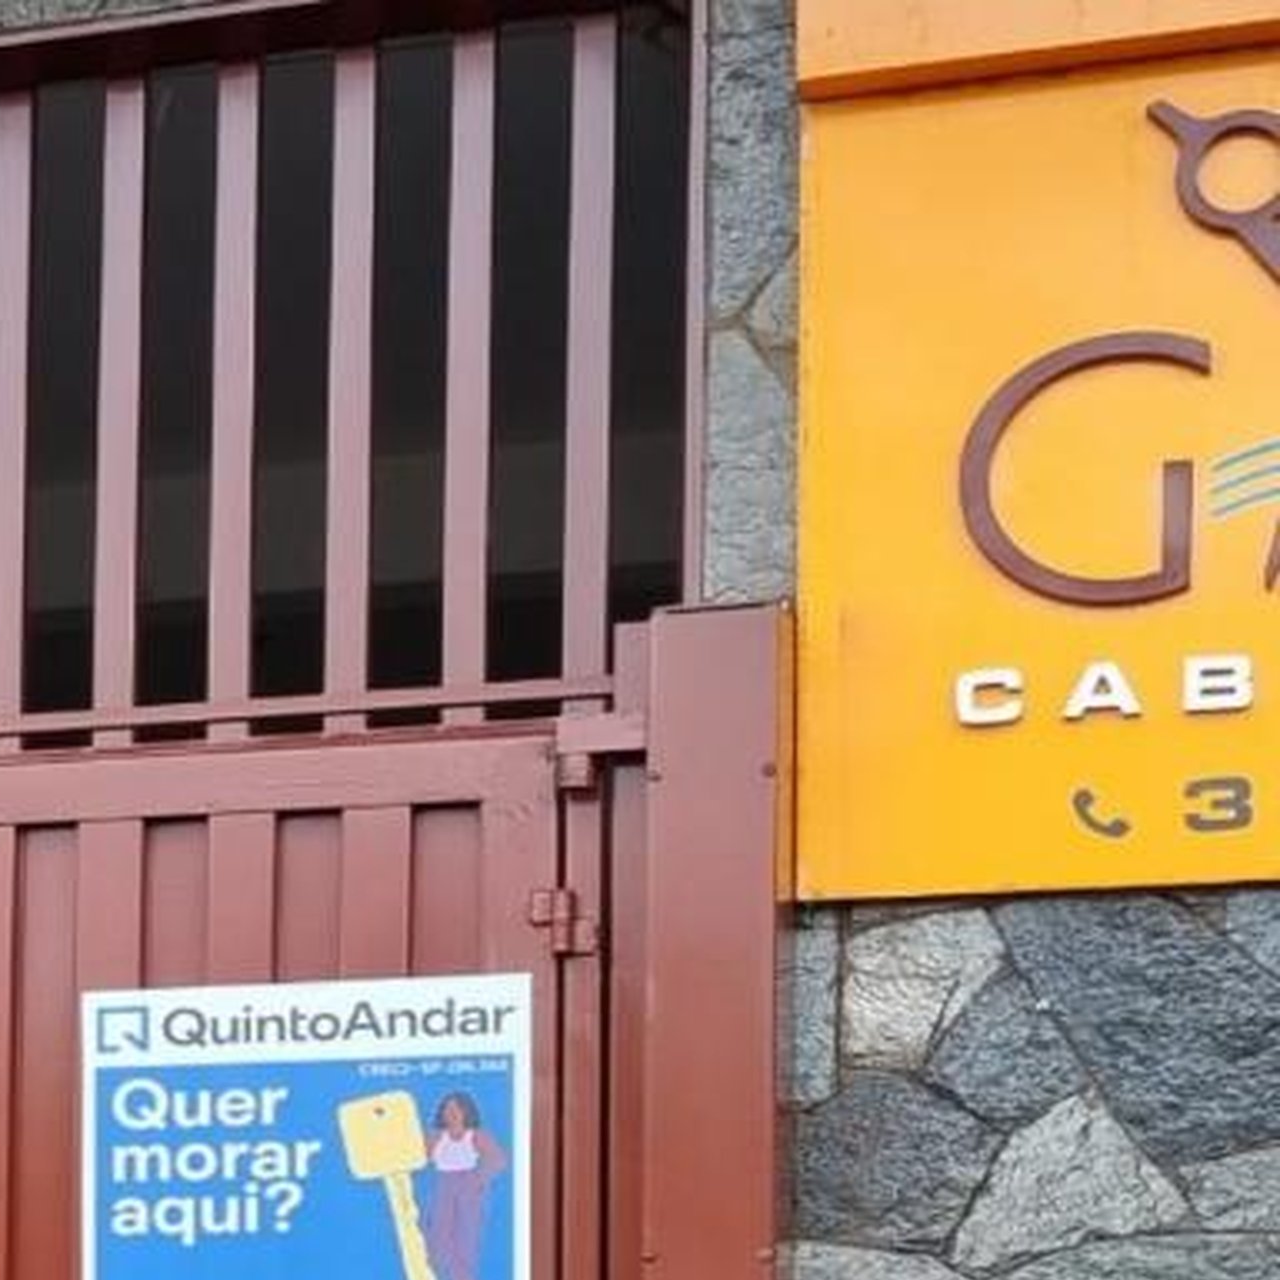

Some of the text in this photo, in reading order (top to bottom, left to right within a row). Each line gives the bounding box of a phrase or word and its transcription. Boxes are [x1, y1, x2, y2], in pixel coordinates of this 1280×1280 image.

[954, 655, 1255, 727] CAB
[162, 998, 516, 1047] QuintoAndar
[111, 1079, 288, 1130] Quer
[111, 1138, 321, 1182] morar
[110, 1181, 304, 1246] aqui?
